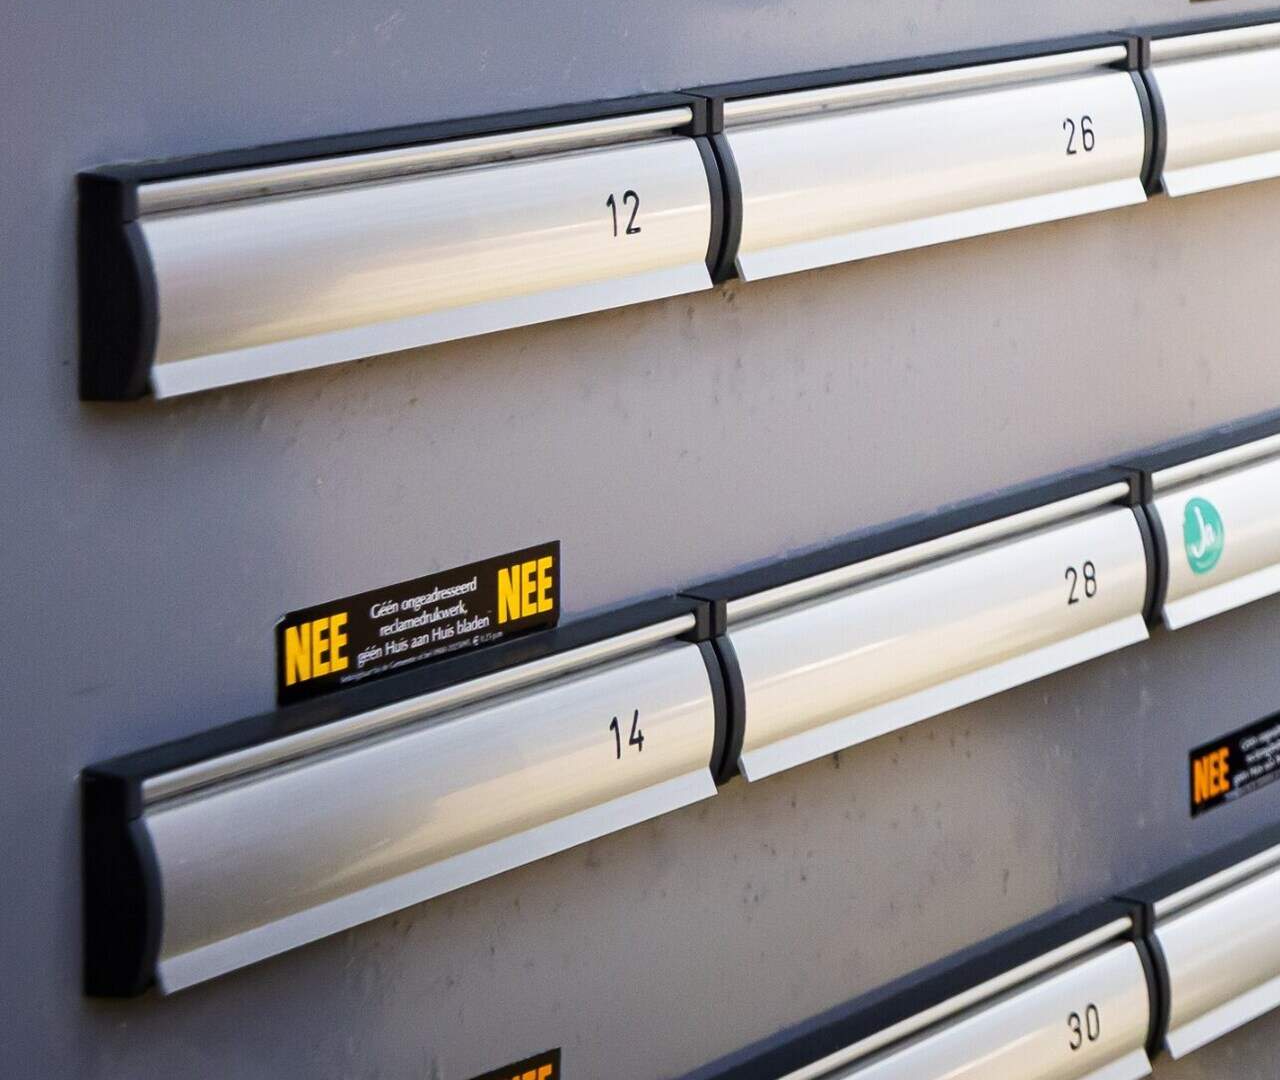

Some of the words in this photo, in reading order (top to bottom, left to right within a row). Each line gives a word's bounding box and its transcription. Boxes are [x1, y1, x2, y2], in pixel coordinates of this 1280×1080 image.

[1063, 115, 1095, 155] 26
[606, 189, 641, 237] 12
[370, 600, 399, 619] Géén
[401, 576, 477, 612] ongeadresseerd
[497, 556, 553, 624] NEE
[1065, 561, 1097, 605] 28
[285, 612, 349, 687] NEE
[357, 644, 383, 668] géén
[384, 638, 409, 657] Huis
[410, 633, 430, 649] aan
[431, 624, 455, 642] Huis
[456, 614, 490, 635] bladen
[609, 709, 644, 760] 14
[1194, 746, 1230, 803] NEE
[1068, 1003, 1099, 1051] 30
